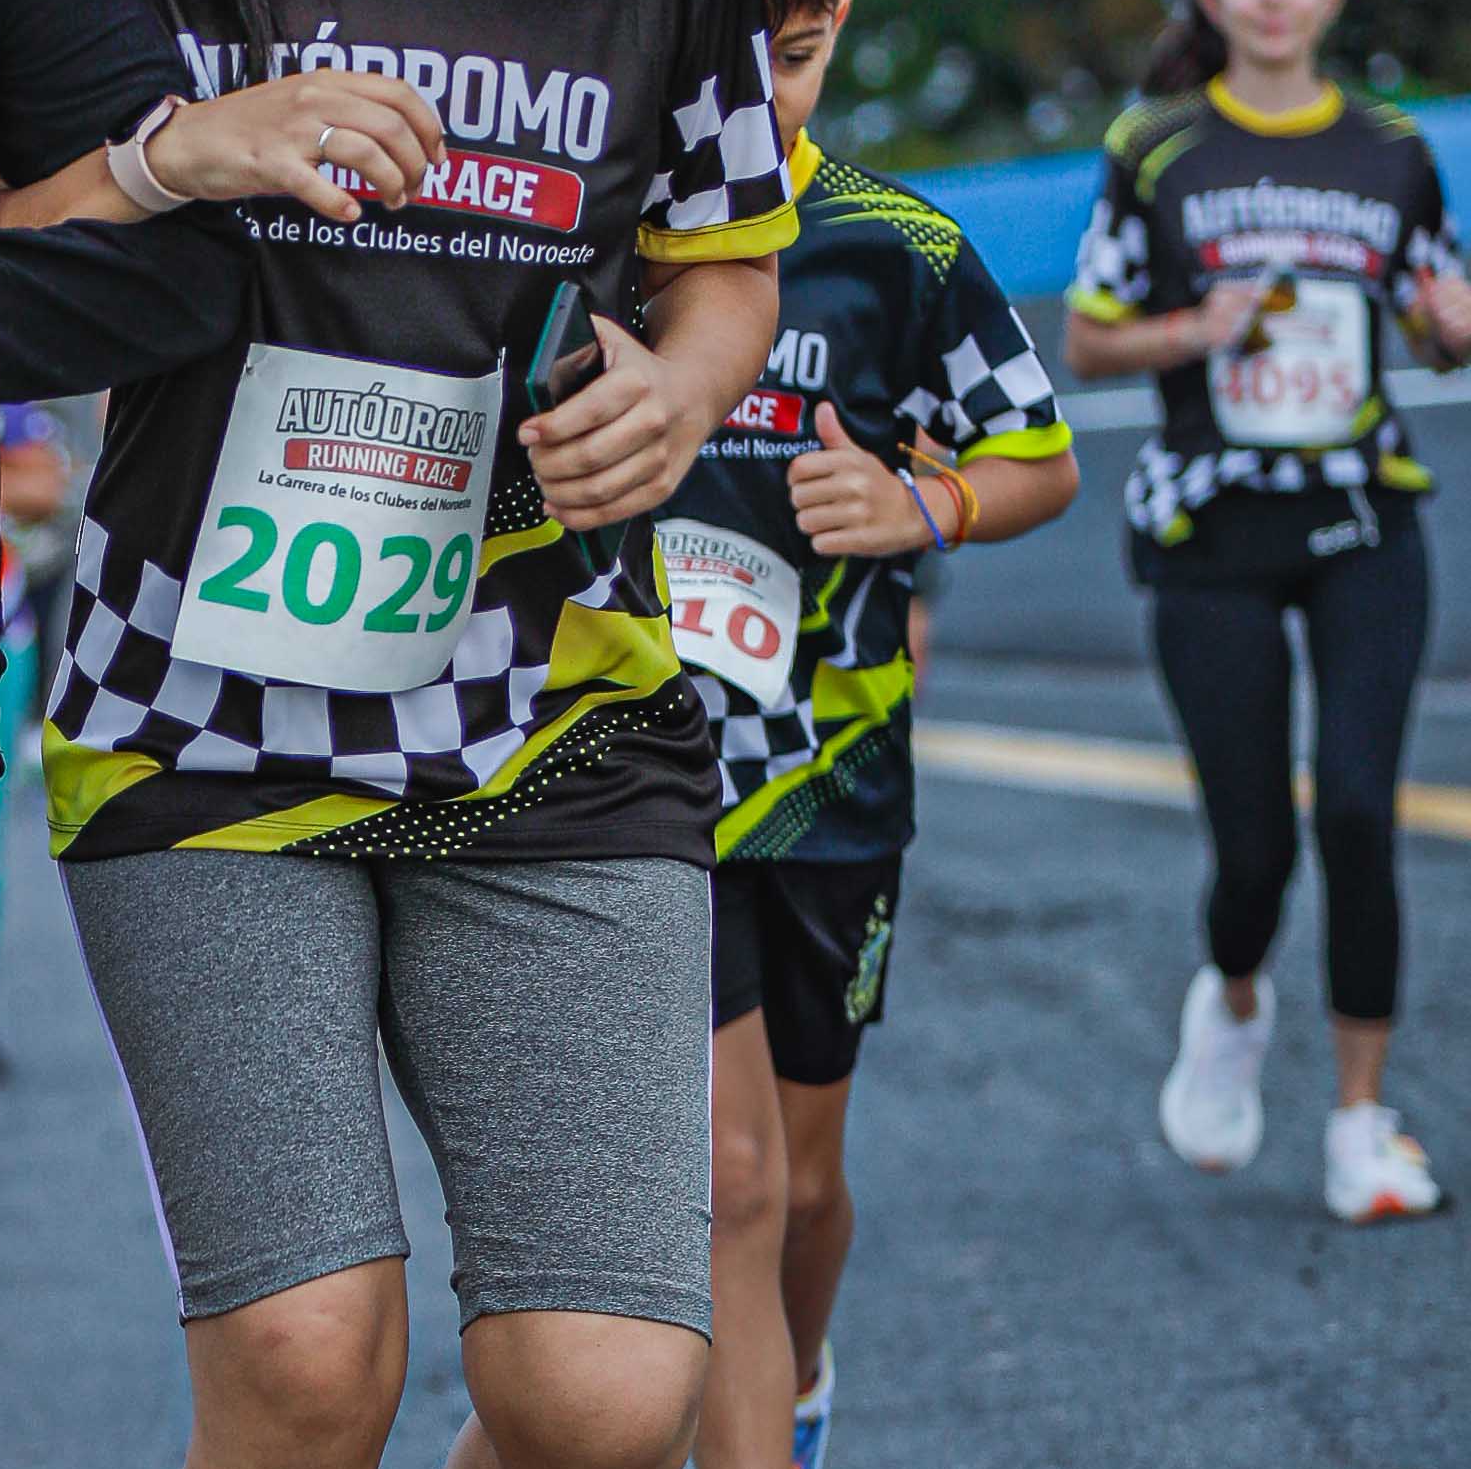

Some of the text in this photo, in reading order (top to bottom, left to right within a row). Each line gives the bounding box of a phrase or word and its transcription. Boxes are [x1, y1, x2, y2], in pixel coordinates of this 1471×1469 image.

[420, 158, 540, 217] RACE
[268, 215, 300, 241] de
[309, 217, 345, 245] los
[352, 221, 441, 255] Clubes
[449, 231, 491, 259] del
[498, 238, 595, 265] Noroeste
[727, 393, 779, 430] ACE
[307, 443, 461, 488] RUNNING RACE
[721, 438, 751, 459] del
[258, 469, 274, 484] La
[276, 473, 325, 495] Carrera
[329, 482, 347, 498] de
[350, 487, 370, 503] los
[374, 491, 418, 511] Clubes
[420, 496, 438, 511] del
[198, 505, 474, 634] 2029
